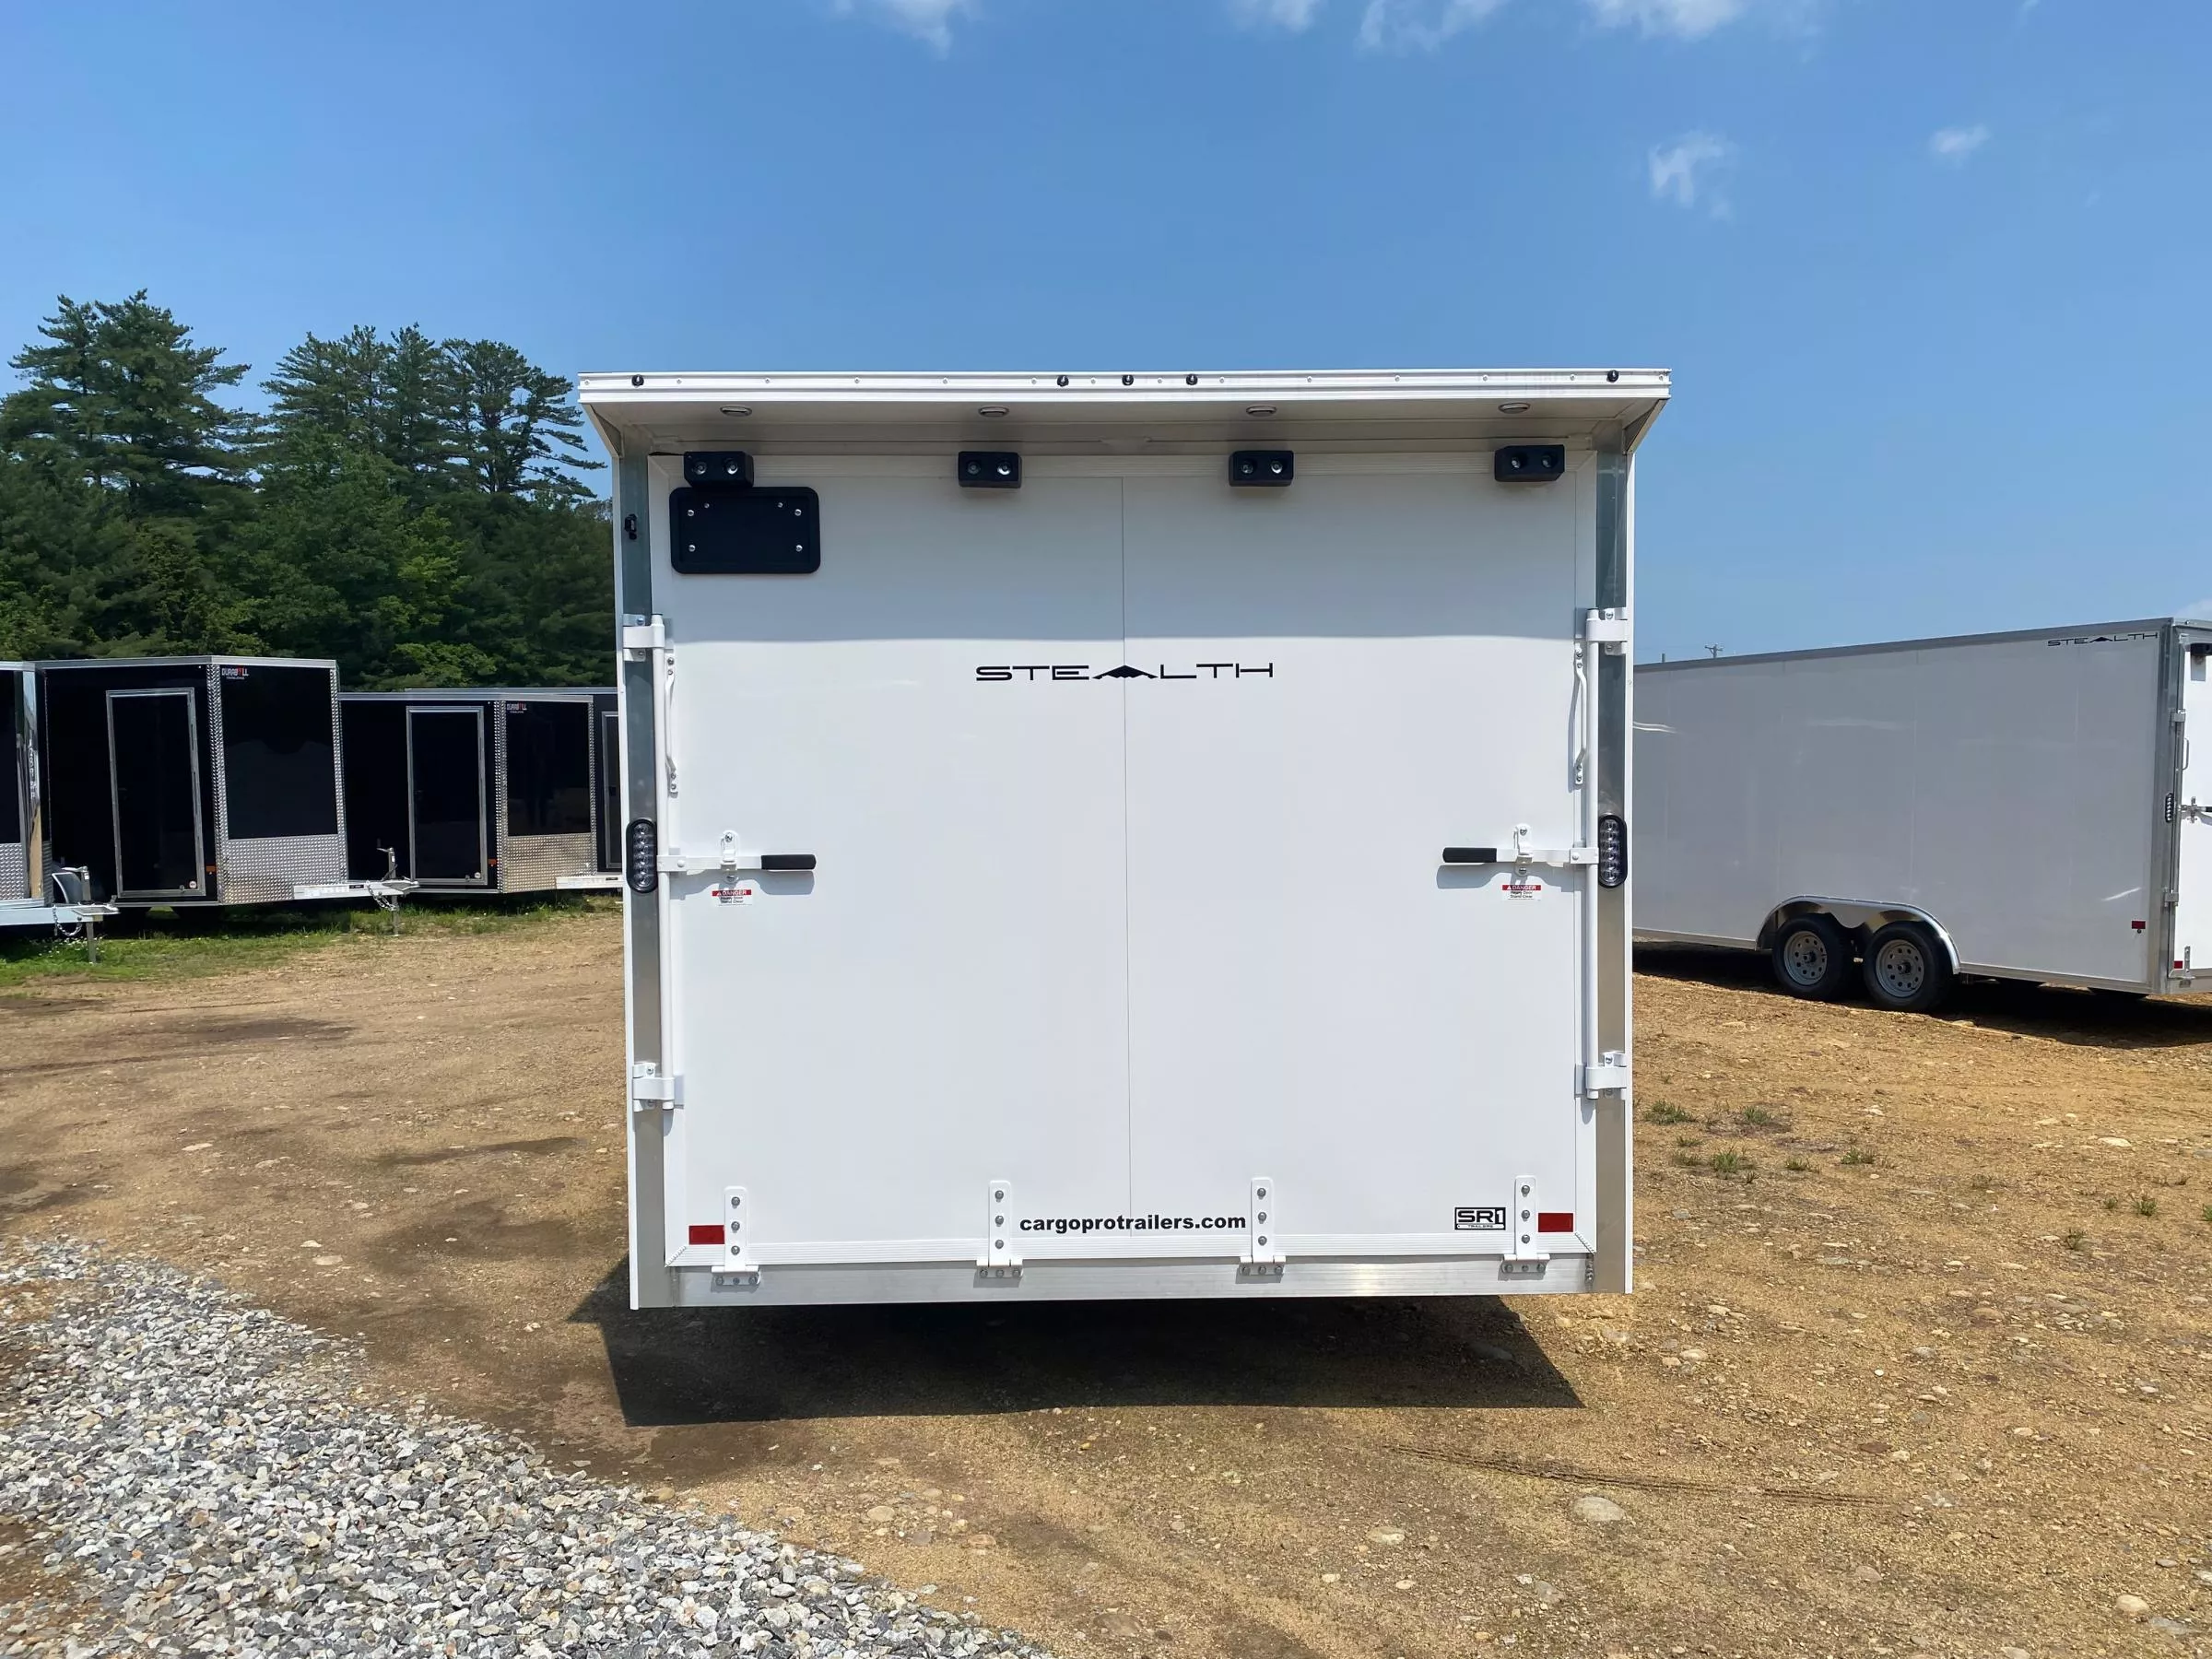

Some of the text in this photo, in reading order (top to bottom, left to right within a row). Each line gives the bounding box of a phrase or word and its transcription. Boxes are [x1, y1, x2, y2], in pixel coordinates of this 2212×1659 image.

[2047, 632, 2159, 647] STEALTH
[975, 662, 1274, 681] STEALTH
[1019, 1214, 1246, 1233] cargoprotrailers.com
[1457, 1209, 1503, 1223] SR1
